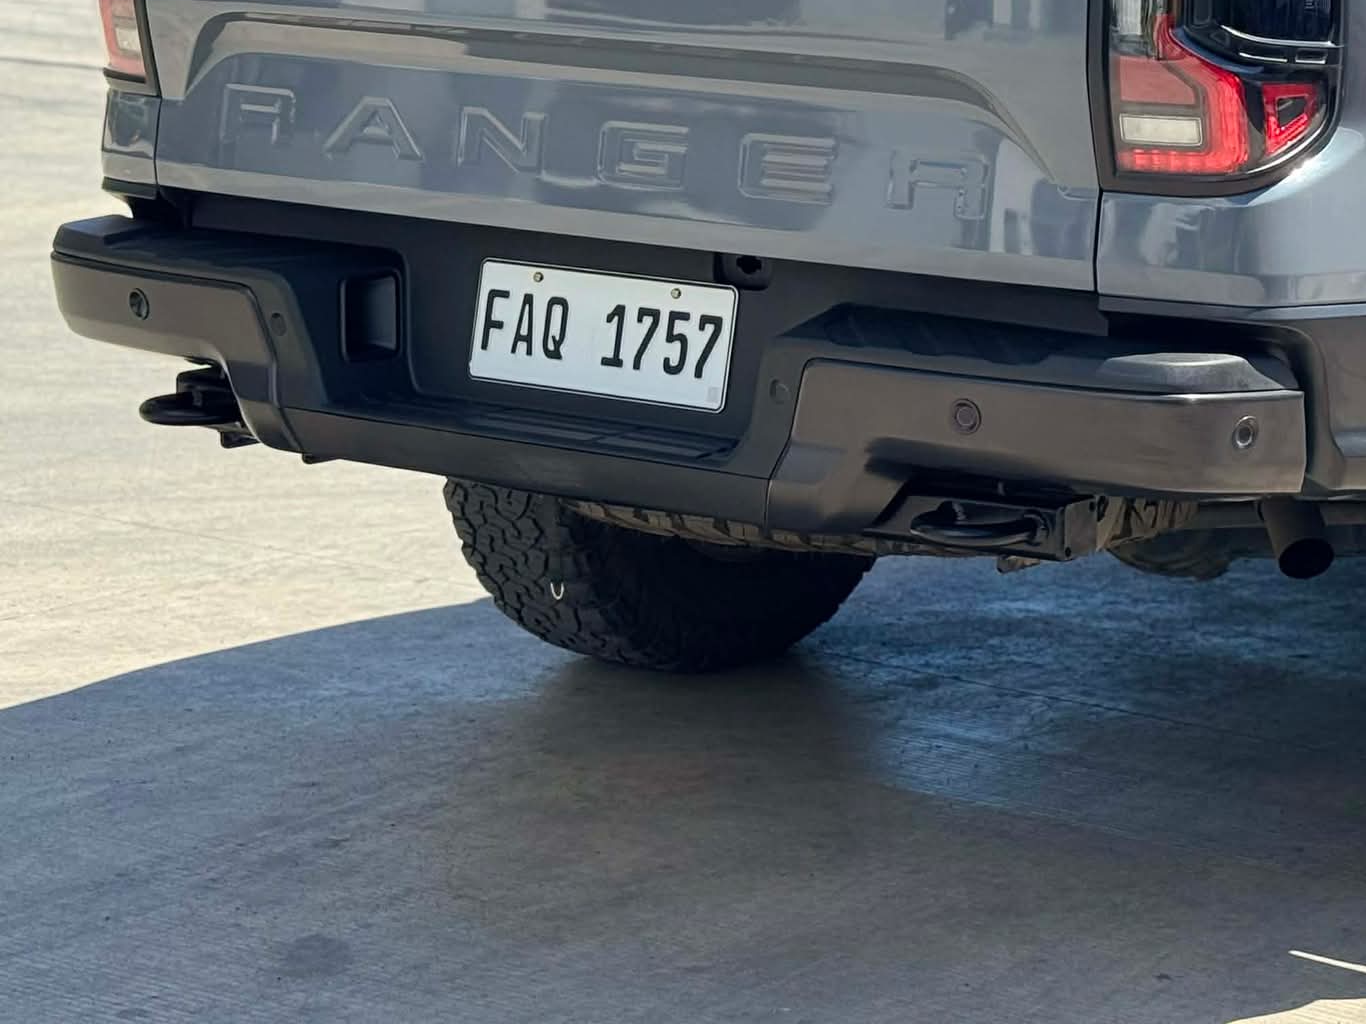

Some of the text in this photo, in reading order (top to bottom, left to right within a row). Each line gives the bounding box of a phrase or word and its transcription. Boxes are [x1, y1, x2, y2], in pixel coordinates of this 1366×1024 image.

[219, 83, 989, 221] RANGER
[481, 288, 724, 380] FAQ 1757
